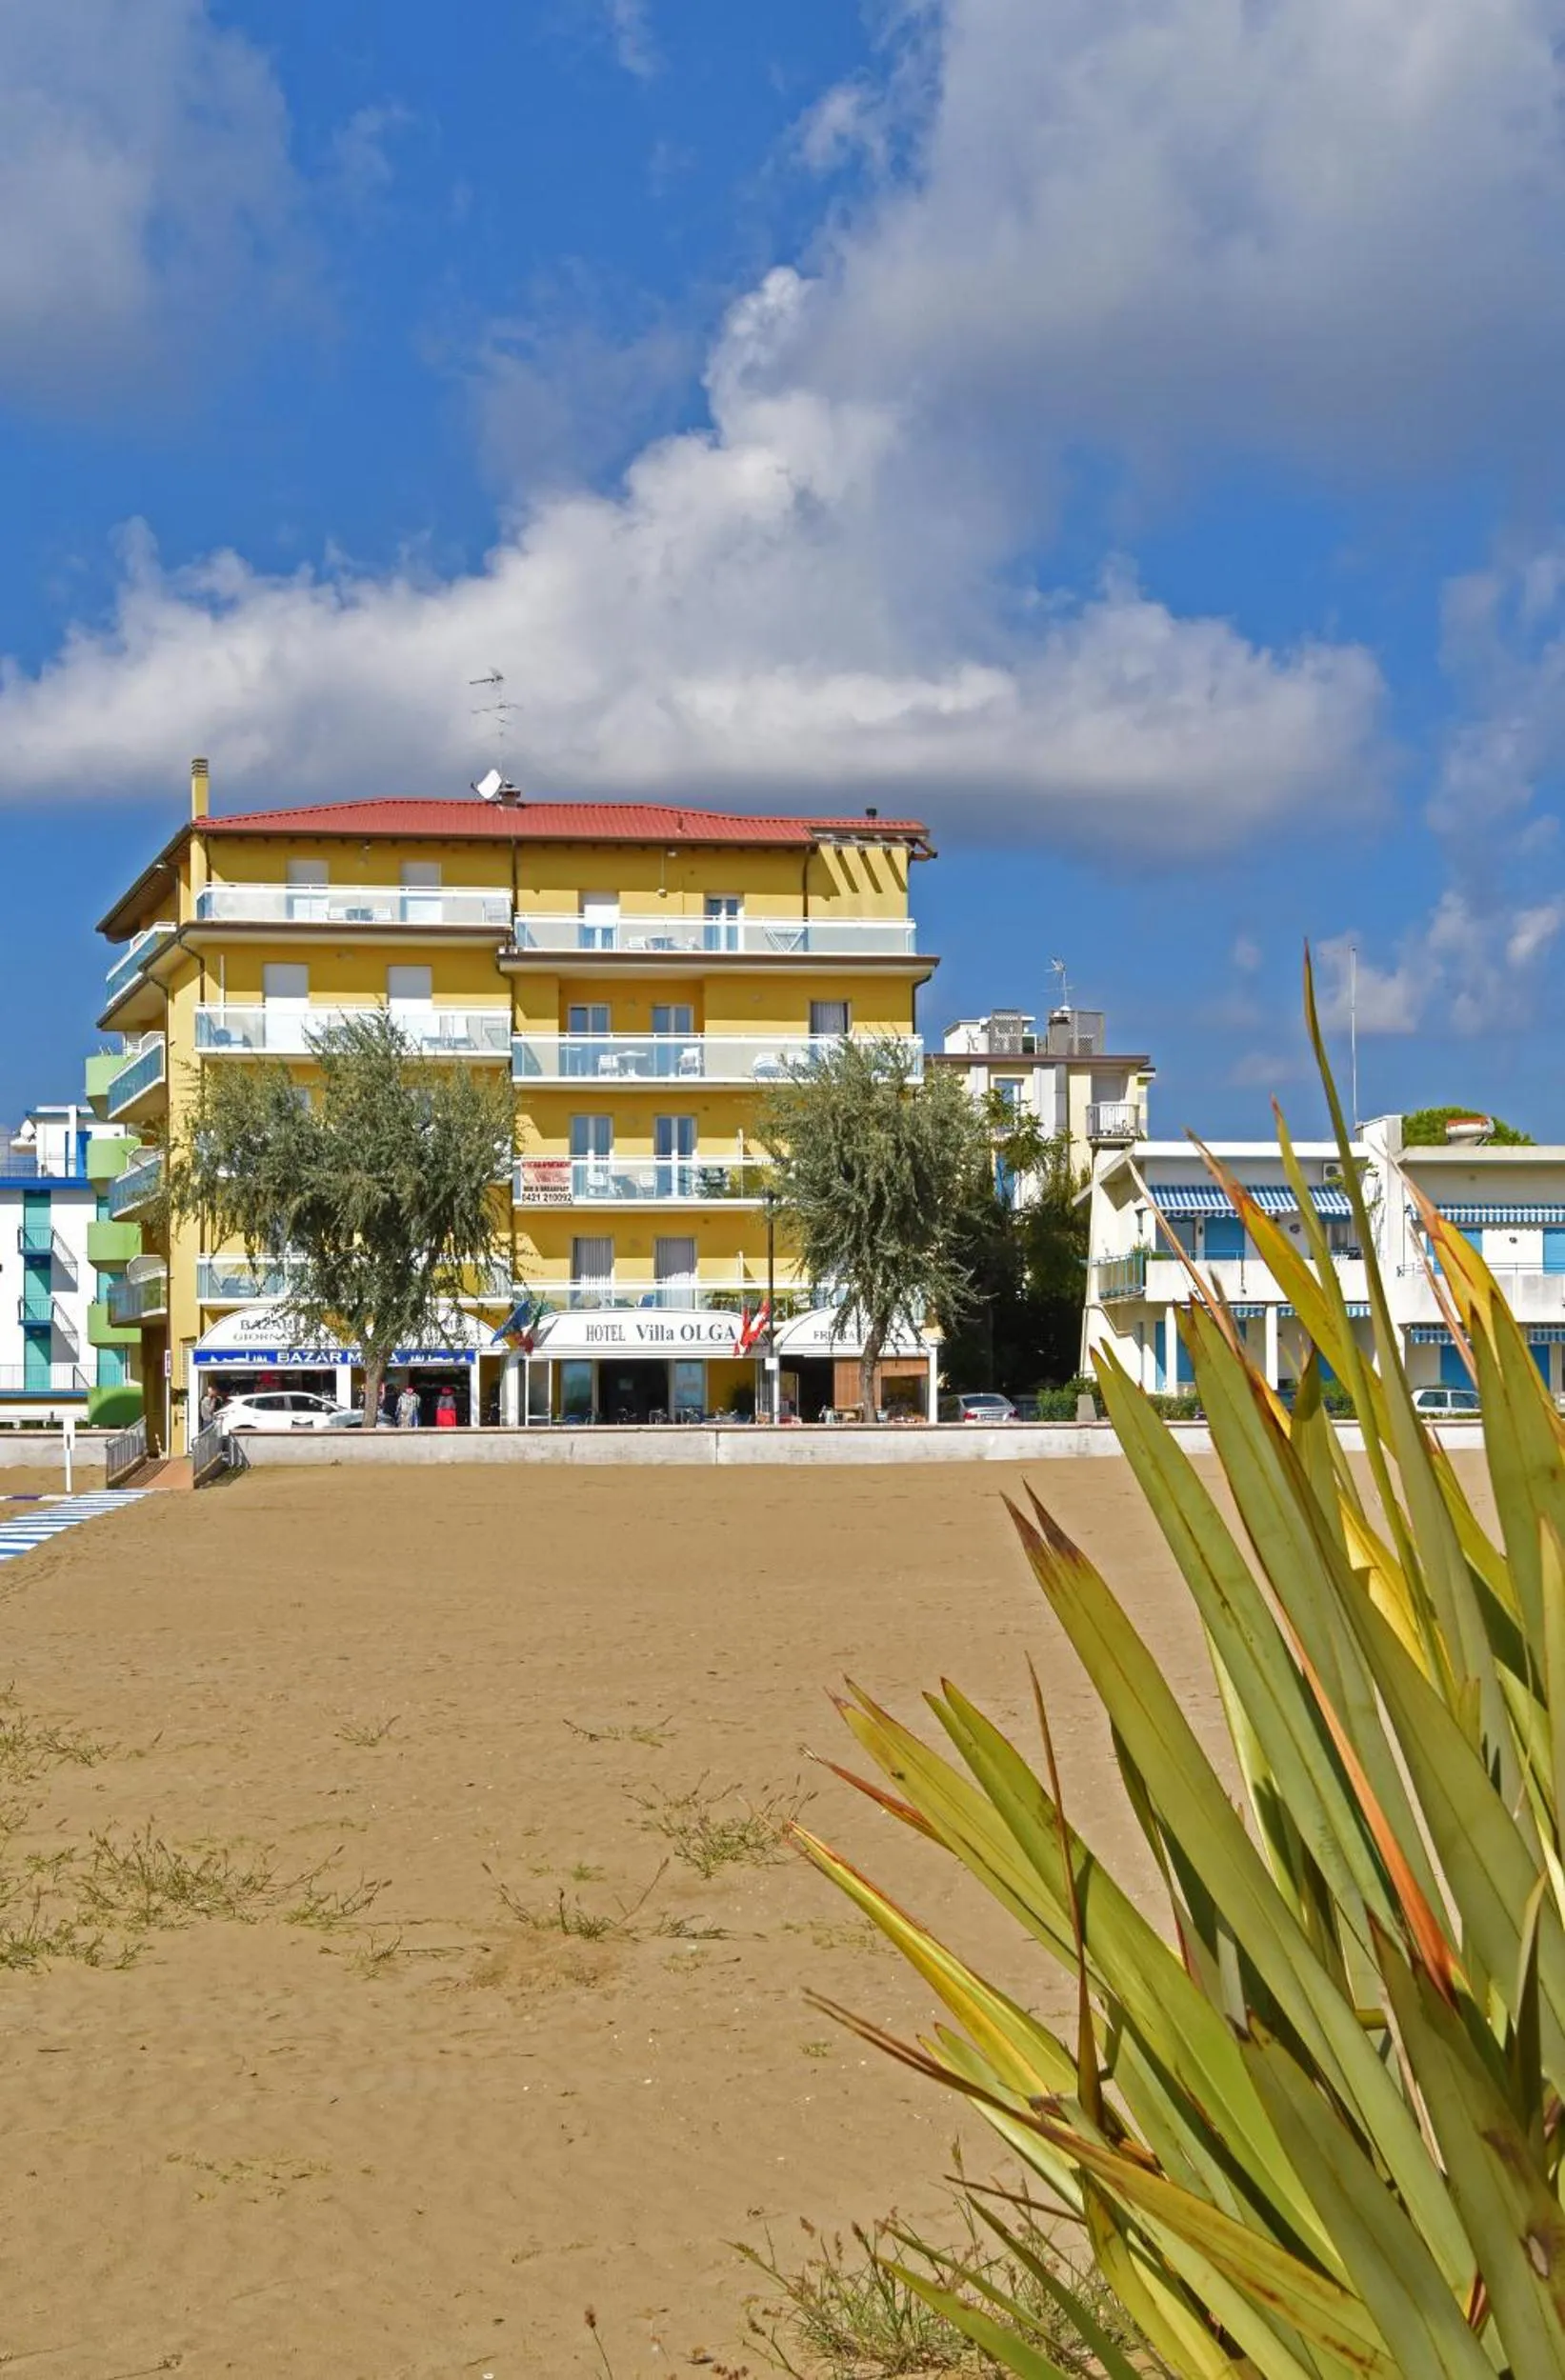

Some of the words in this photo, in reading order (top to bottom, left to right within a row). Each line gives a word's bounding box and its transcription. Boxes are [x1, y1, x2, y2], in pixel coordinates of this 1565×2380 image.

[586, 1325, 626, 1342] HOTEL
[635, 1325, 674, 1341] Villa
[680, 1324, 736, 1341] OLGA
[276, 1352, 343, 1363] BAZAR
